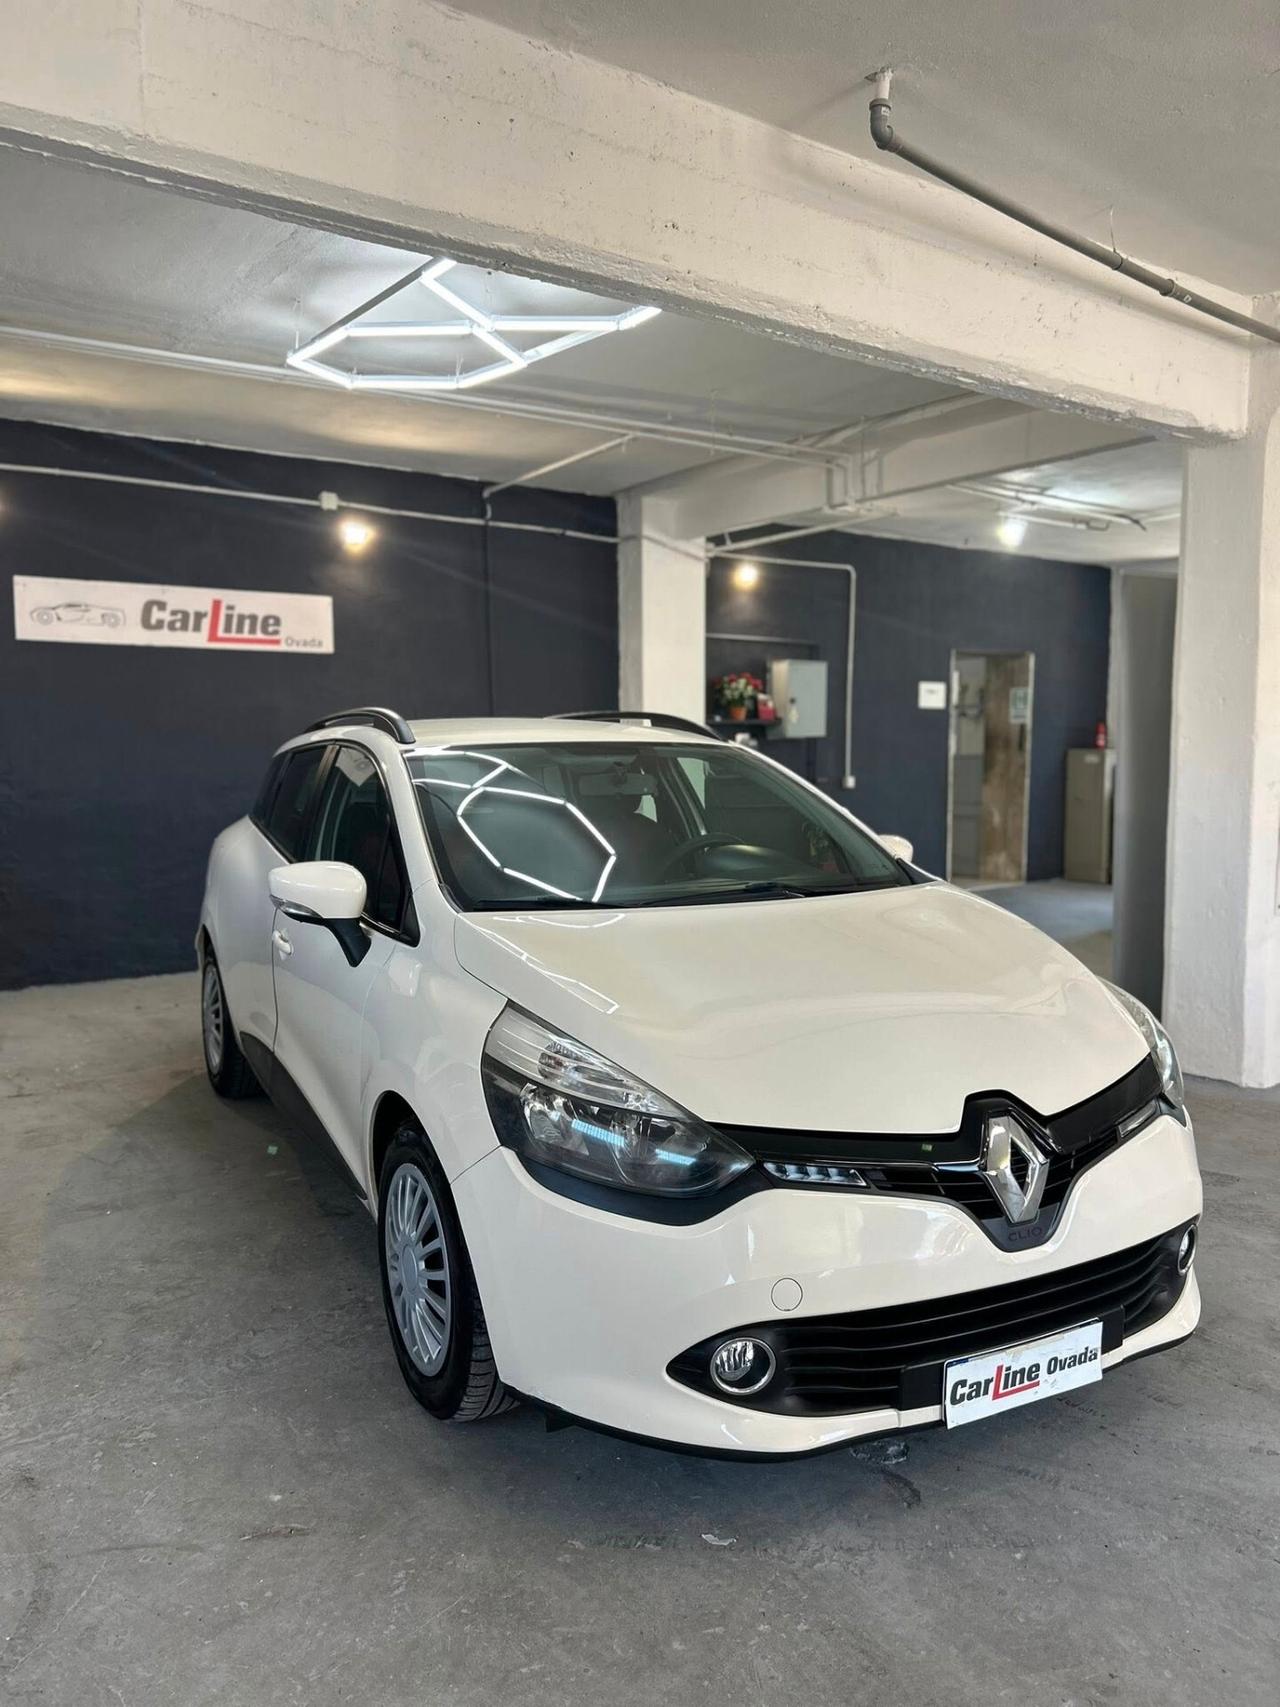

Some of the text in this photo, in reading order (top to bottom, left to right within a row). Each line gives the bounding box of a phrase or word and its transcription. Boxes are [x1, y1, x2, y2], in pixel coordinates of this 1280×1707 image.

[140, 599, 282, 646] CarLine
[284, 636, 324, 649] Ovada
[1007, 1226, 1043, 1242] CLIO
[950, 1346, 1099, 1406] CarLine Ovada
